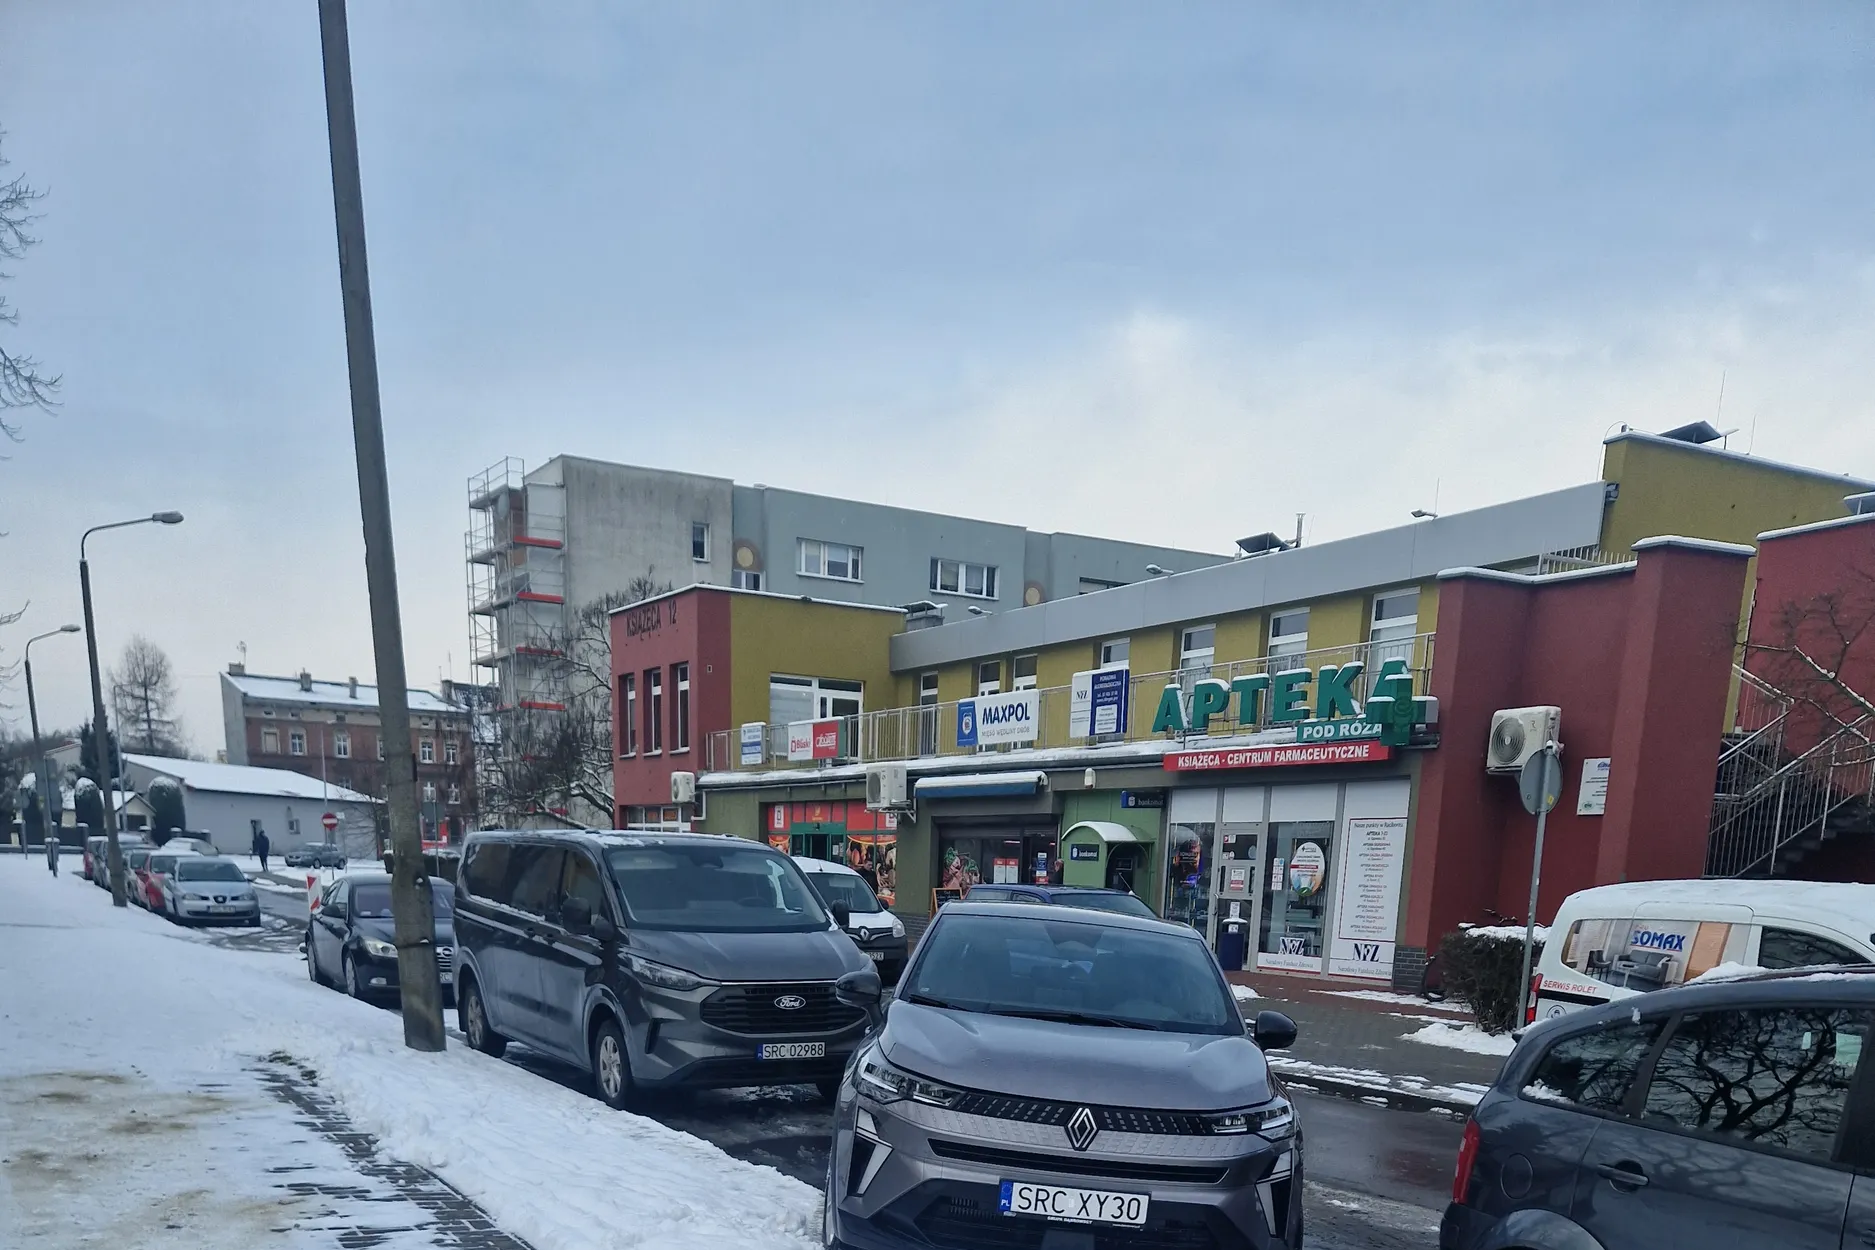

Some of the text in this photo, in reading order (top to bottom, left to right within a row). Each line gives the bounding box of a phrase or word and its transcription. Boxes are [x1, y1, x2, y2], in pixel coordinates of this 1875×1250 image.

[668, 600, 677, 625] 12
[1152, 658, 1409, 732] APTEKA
[982, 702, 1031, 725] MAXPOL
[1303, 724, 1335, 739] POD
[1178, 753, 1220, 769] KSIĄŻĘCA
[1227, 750, 1272, 765] CENTRUM
[1274, 744, 1370, 762] FARMACEUTYCZNE
[1631, 930, 1686, 950] SOMAX
[1353, 943, 1381, 962] NFZ
[1571, 984, 1598, 995] ROLET
[780, 998, 801, 1007] Ford
[764, 1044, 824, 1058] SRC 02988
[1018, 1186, 1067, 1214] SRC
[1077, 1193, 1141, 1221] XY30
